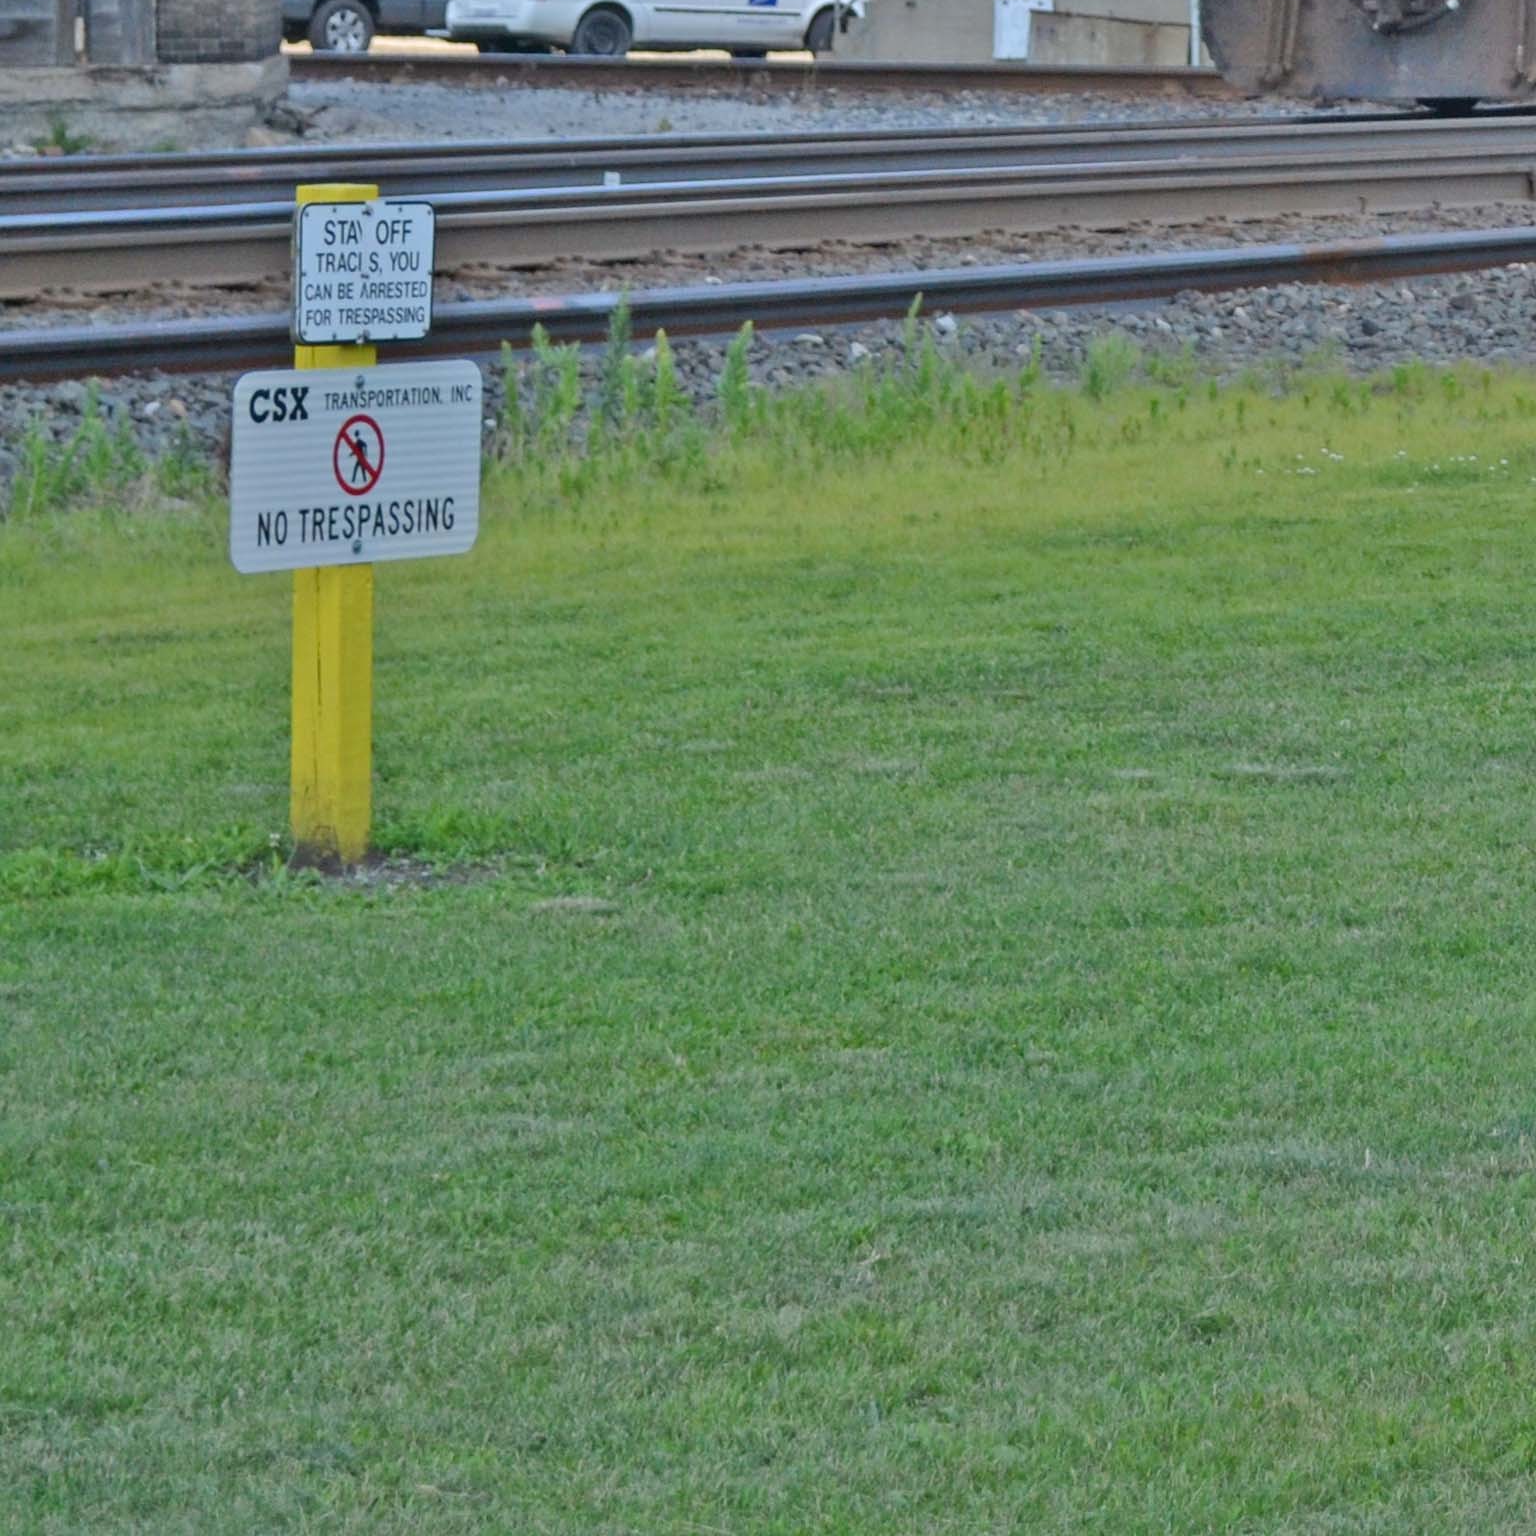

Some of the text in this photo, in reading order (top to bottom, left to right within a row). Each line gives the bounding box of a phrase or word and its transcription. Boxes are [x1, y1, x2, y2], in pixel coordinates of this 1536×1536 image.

[375, 219, 413, 244] OFF
[389, 251, 420, 271] YOU
[304, 281, 428, 301] CAN BE ARRESTED
[305, 306, 425, 327] FOR TRESPASSING
[249, 386, 309, 423] CSX
[257, 496, 456, 547] NO TRESPASSING
